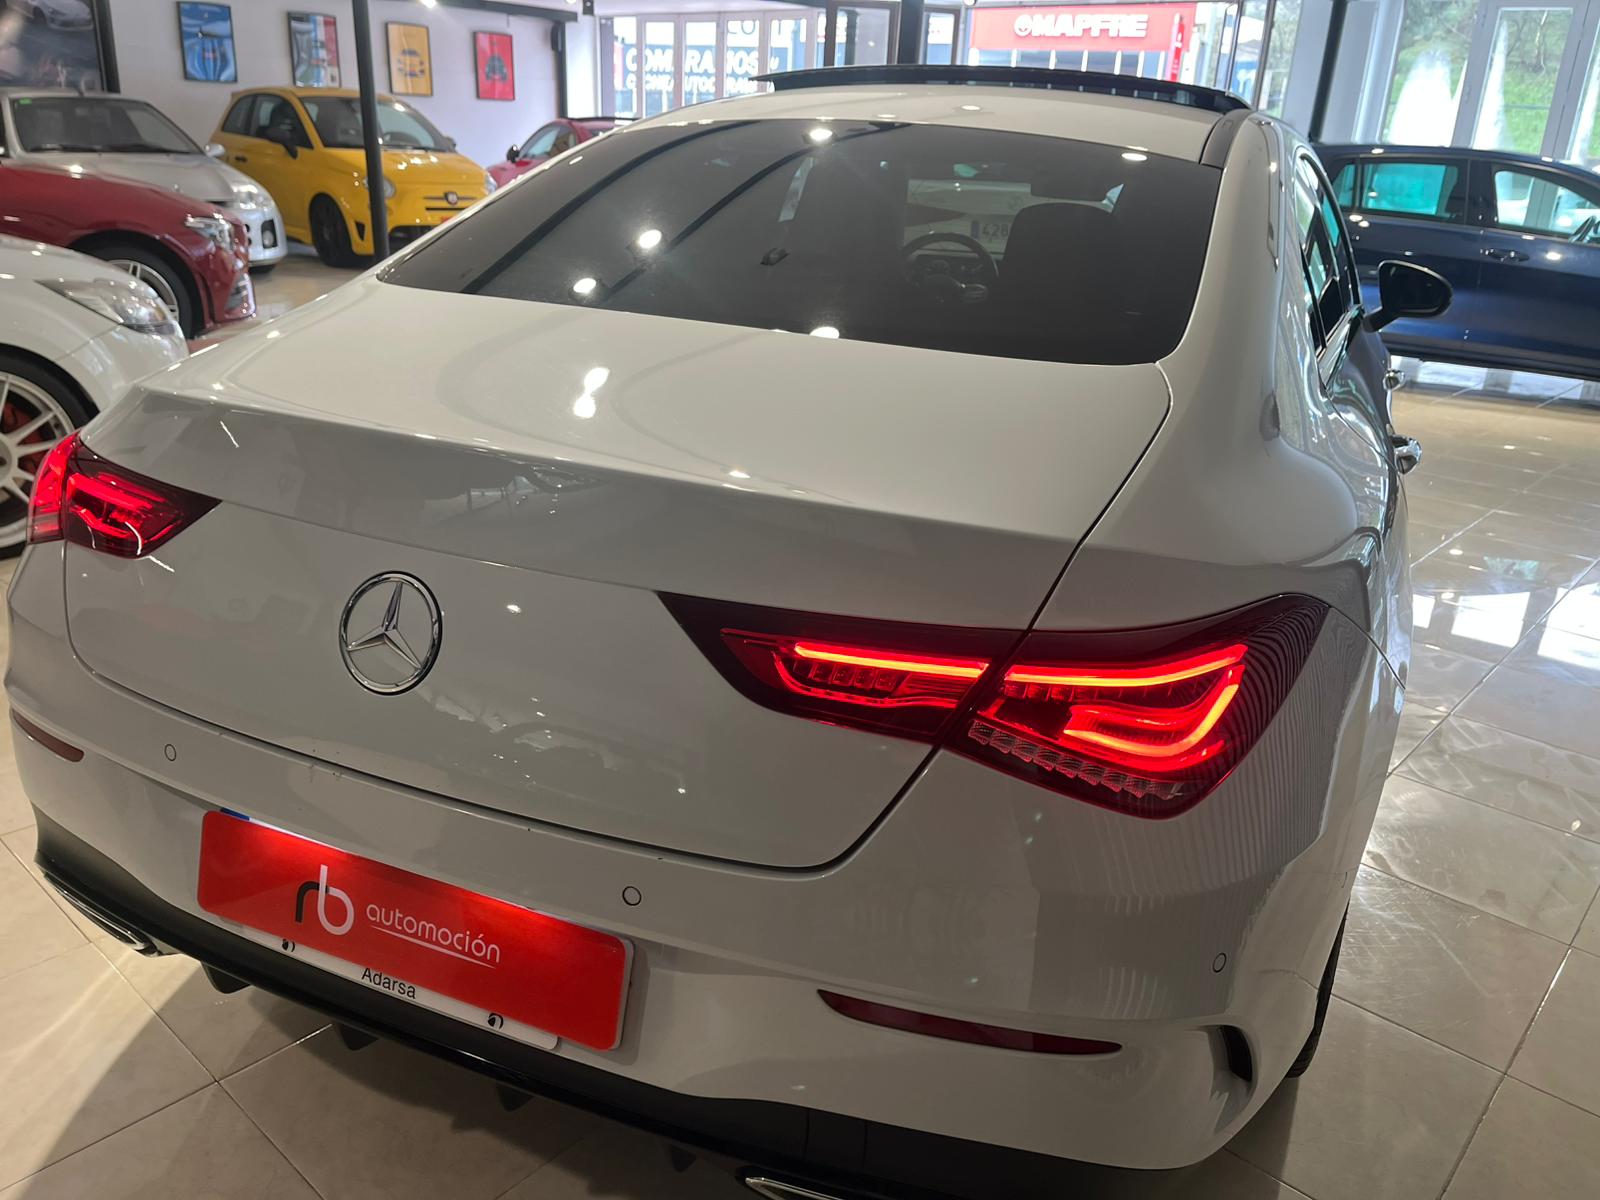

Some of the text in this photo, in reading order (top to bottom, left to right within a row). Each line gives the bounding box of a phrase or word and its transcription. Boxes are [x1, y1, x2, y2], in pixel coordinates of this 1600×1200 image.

[1031, 14, 1148, 38] MAPFRE
[366, 903, 500, 963] automoción
[361, 967, 416, 1000] Adarsa
